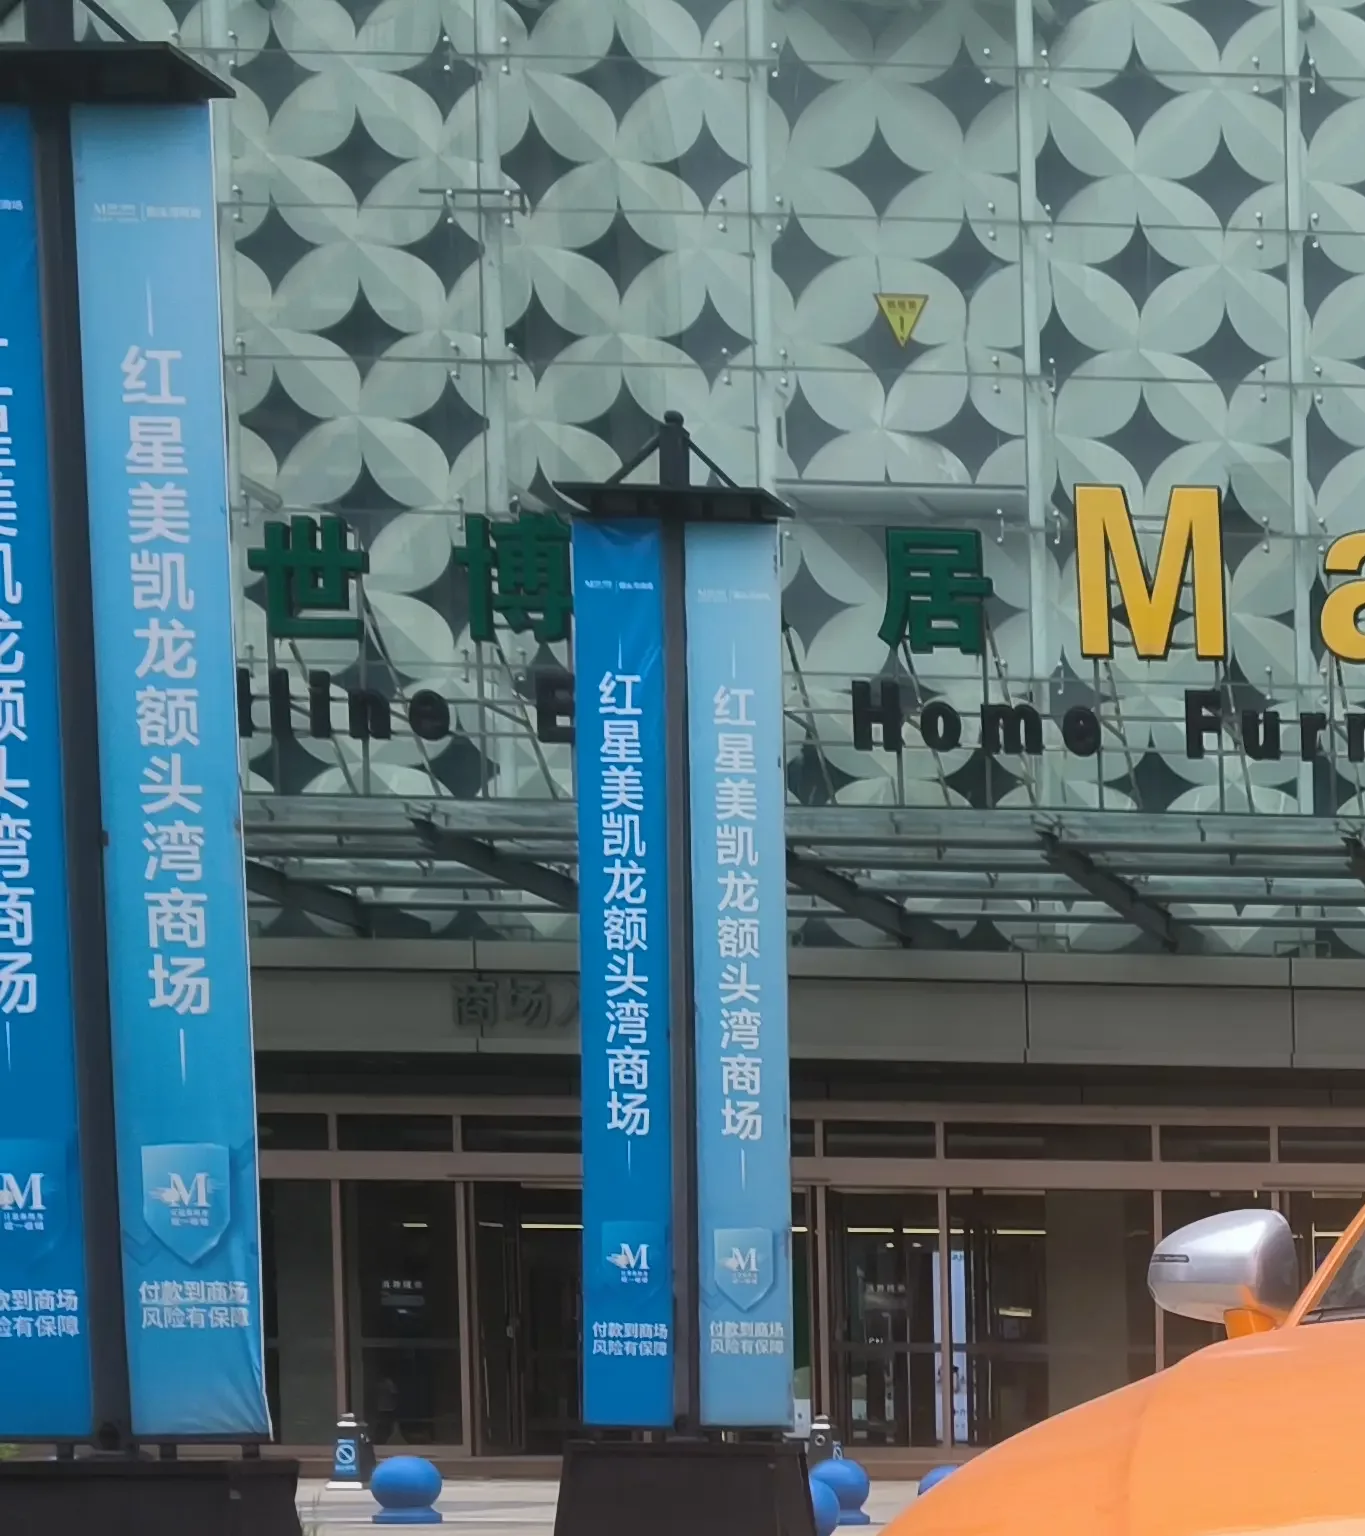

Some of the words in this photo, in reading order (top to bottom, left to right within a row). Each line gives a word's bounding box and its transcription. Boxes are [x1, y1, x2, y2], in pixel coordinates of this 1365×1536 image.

[121, 345, 211, 1015] 红星美凯龙额头湾商场
[851, 680, 1101, 757] Home
[598, 671, 652, 1137] 红星美凯龙额头湾商场
[712, 685, 764, 1142] 红星美凯龙额头湾商场
[139, 1280, 249, 1305] 付款到商场
[141, 1307, 250, 1329] 风险有保障
[592, 1322, 668, 1339] 付款到商场
[592, 1339, 668, 1356] 风险有保障
